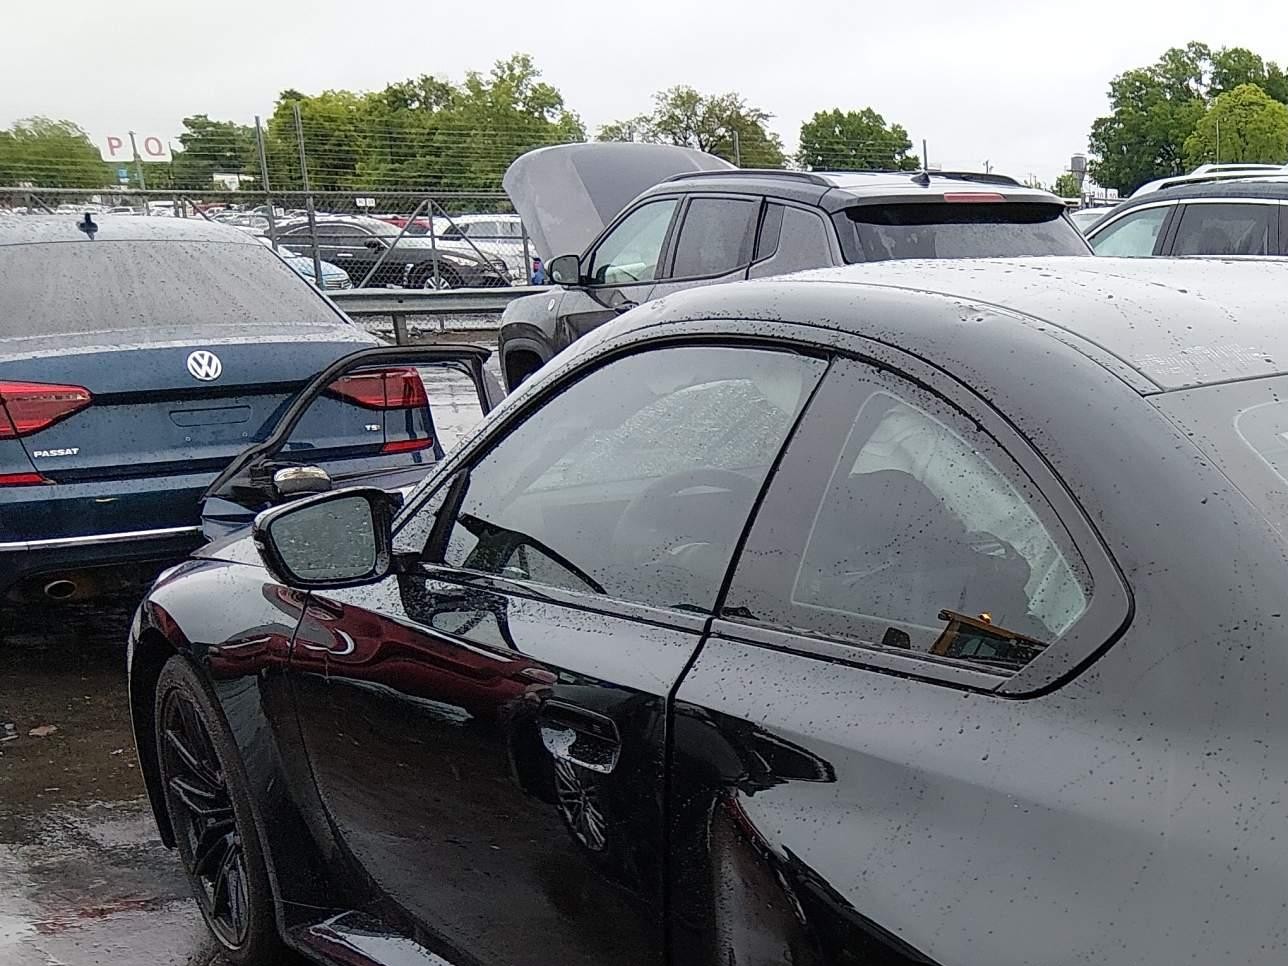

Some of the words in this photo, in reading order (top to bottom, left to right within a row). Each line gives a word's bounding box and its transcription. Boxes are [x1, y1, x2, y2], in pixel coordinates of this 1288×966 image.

[107, 136, 123, 156] P
[144, 136, 166, 156] Q
[33, 447, 80, 458] PASSAT
